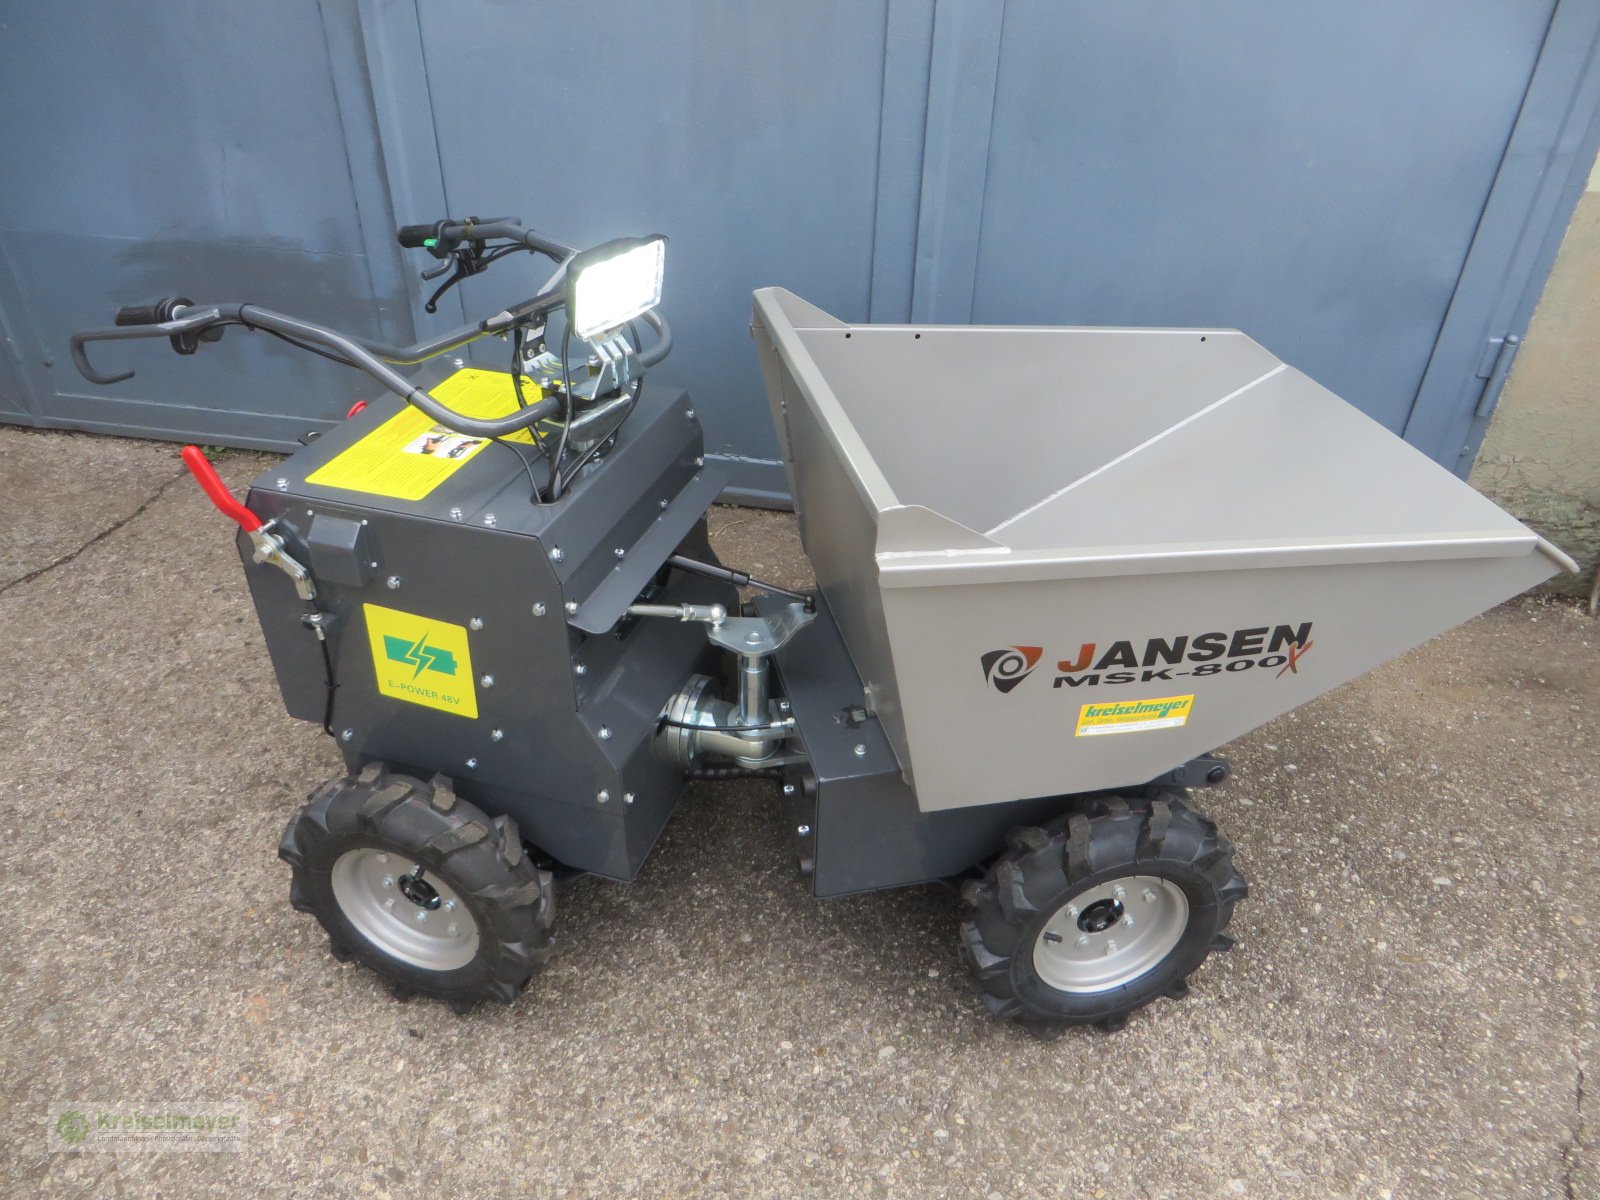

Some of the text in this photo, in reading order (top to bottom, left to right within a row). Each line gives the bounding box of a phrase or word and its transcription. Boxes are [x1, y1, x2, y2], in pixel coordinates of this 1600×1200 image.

[1057, 621, 1313, 673] JANSEN
[387, 679, 461, 705] E-POWER 48V
[1085, 699, 1190, 719] kreiselmeyer
